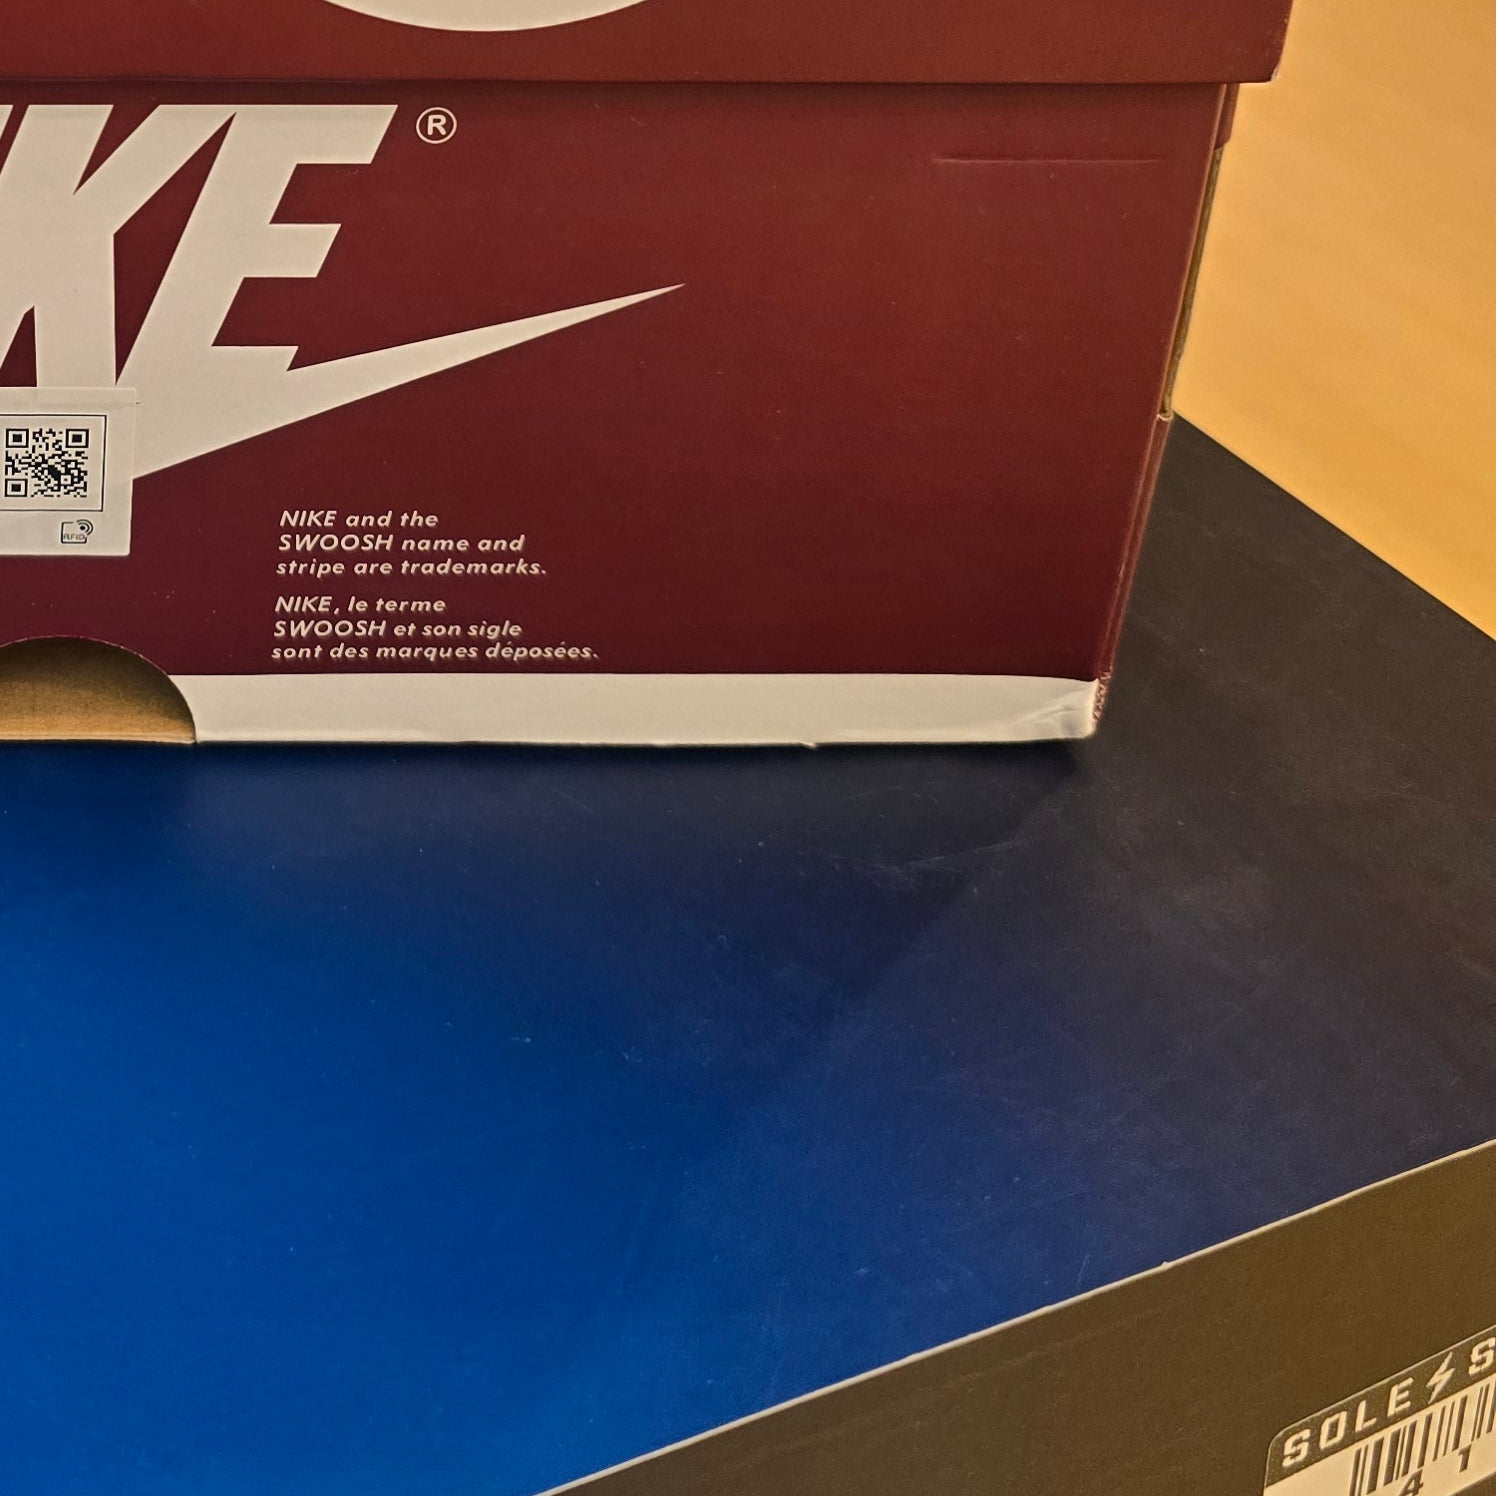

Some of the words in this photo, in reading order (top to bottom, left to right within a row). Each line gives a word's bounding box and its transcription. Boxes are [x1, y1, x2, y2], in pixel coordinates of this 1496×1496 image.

[279, 509, 338, 528] NIKE
[345, 509, 393, 528] and
[399, 509, 440, 528] the
[278, 533, 394, 552] SWOOSH
[401, 536, 470, 552] name
[477, 534, 526, 552] and
[276, 558, 345, 579] stripe
[353, 561, 393, 576] are
[400, 558, 548, 576] trademarks.
[275, 595, 341, 615] NIKE,
[348, 595, 368, 612] le
[375, 597, 447, 612] terme
[273, 620, 387, 638] SWOOSH
[393, 622, 417, 637] et
[421, 624, 462, 637] son
[467, 619, 523, 640] sigle
[271, 644, 323, 660] sont
[330, 642, 369, 659] des
[376, 645, 478, 661] marques
[485, 641, 600, 661] déposées.
[1282, 1377, 1414, 1468] SOLE
